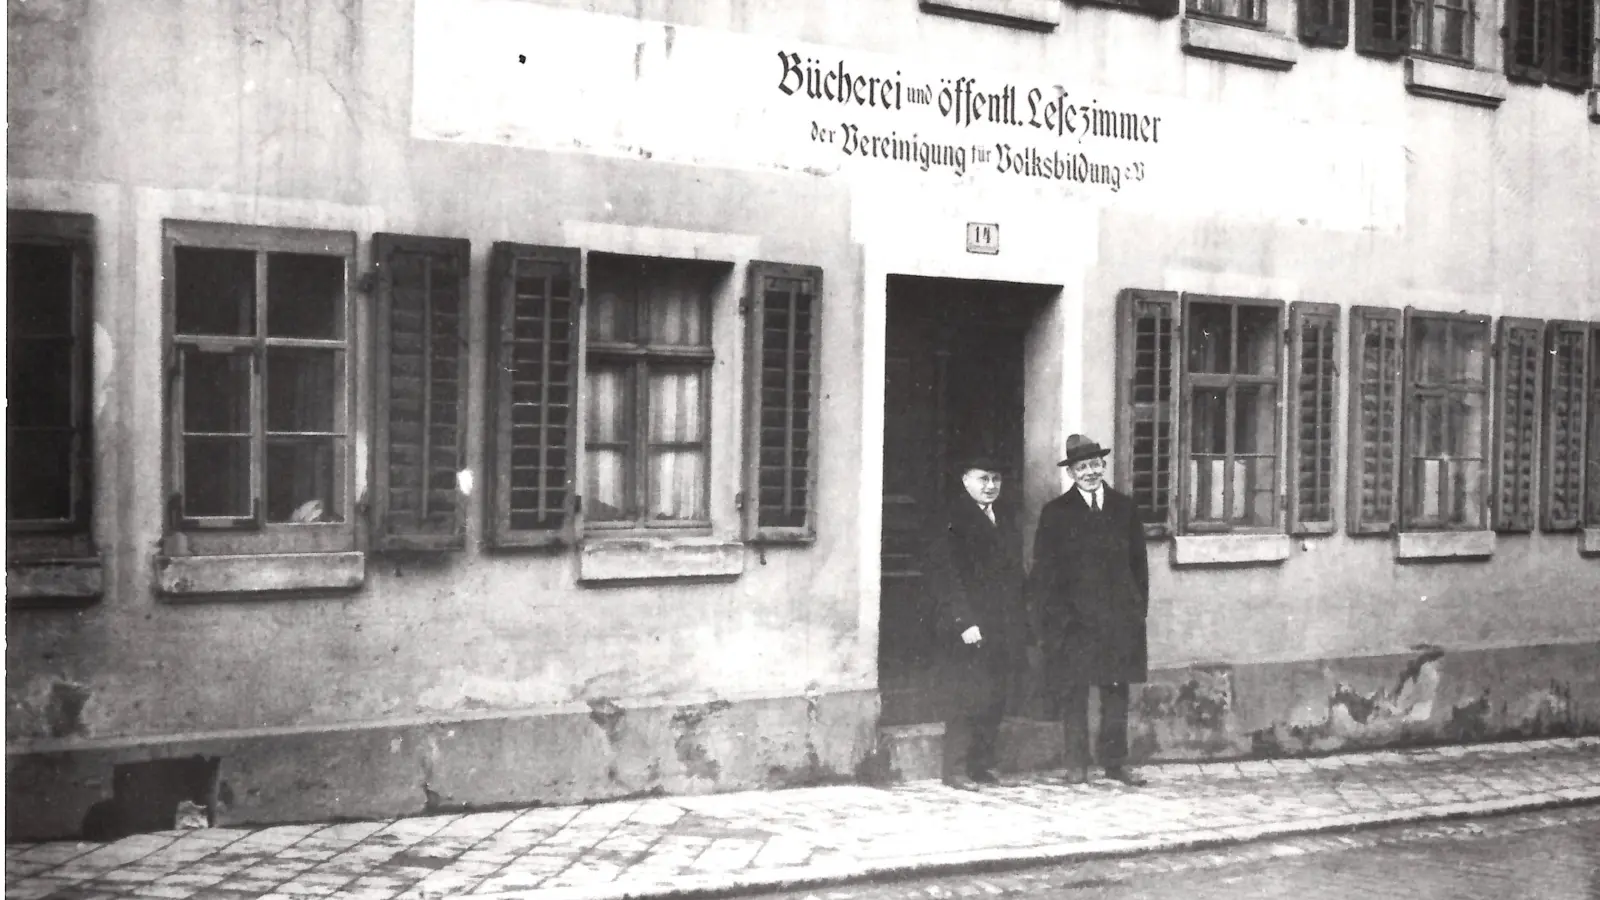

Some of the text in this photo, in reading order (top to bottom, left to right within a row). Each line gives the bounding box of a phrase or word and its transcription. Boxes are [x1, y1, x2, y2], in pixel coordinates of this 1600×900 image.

[776, 49, 902, 112] Bücherei
[906, 83, 933, 106] und
[937, 76, 1024, 128] öffentl.
[810, 119, 838, 144] der
[839, 121, 967, 178] Vereinigung
[970, 144, 992, 165] für
[994, 142, 1122, 193] Volksbildung
[975, 225, 991, 244] 14
